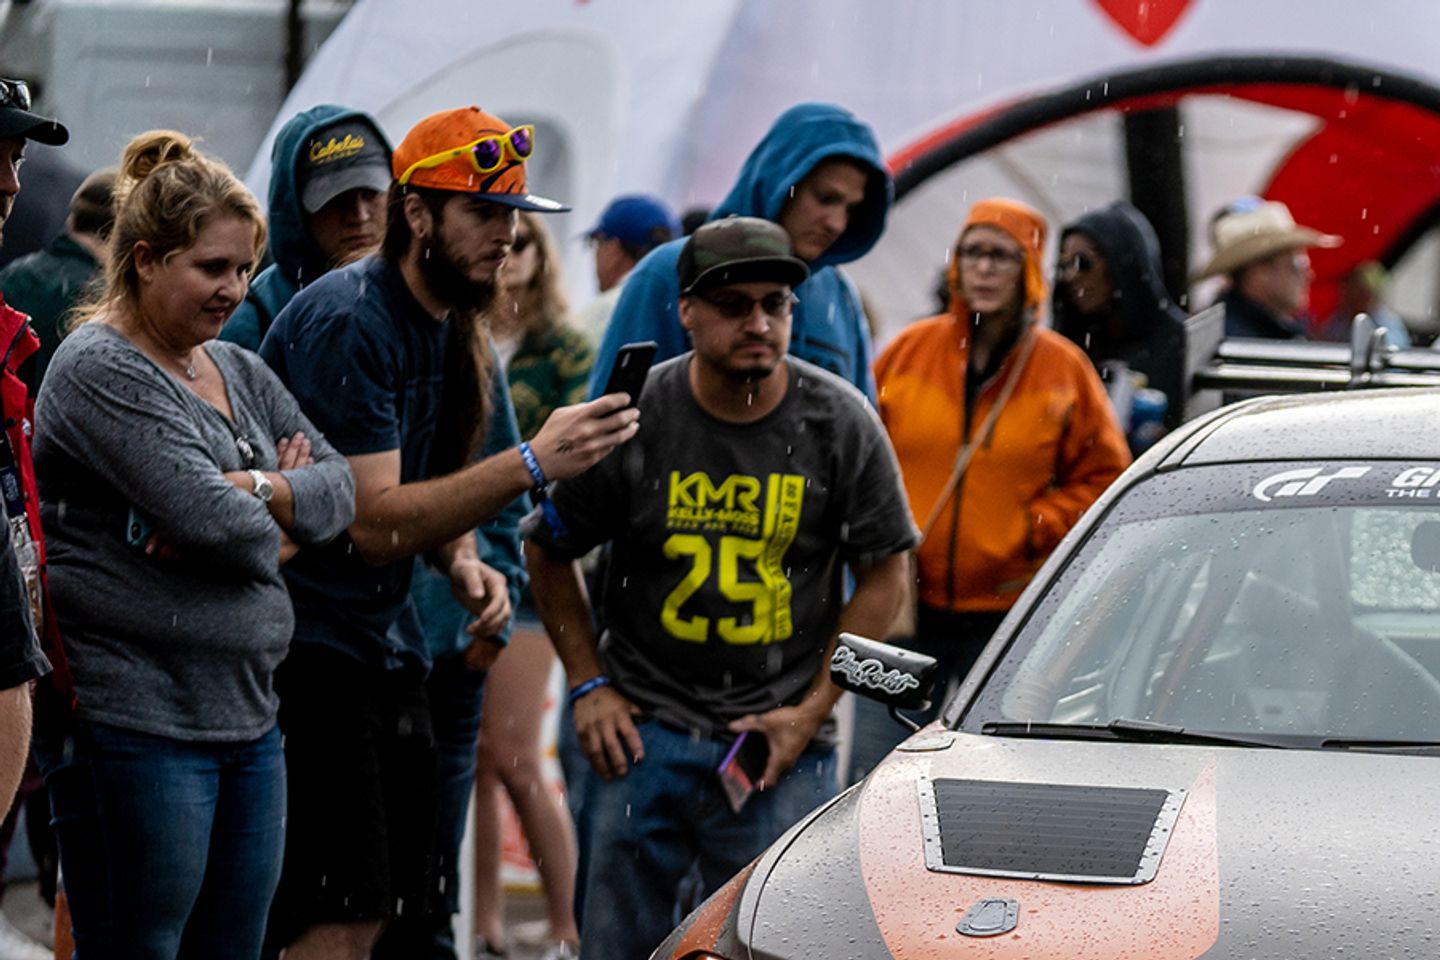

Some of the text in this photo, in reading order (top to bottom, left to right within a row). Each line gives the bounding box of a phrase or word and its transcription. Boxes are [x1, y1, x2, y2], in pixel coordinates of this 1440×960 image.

[668, 470, 762, 513] KMR
[1385, 488, 1429, 499] THE
[661, 532, 773, 646] 25
